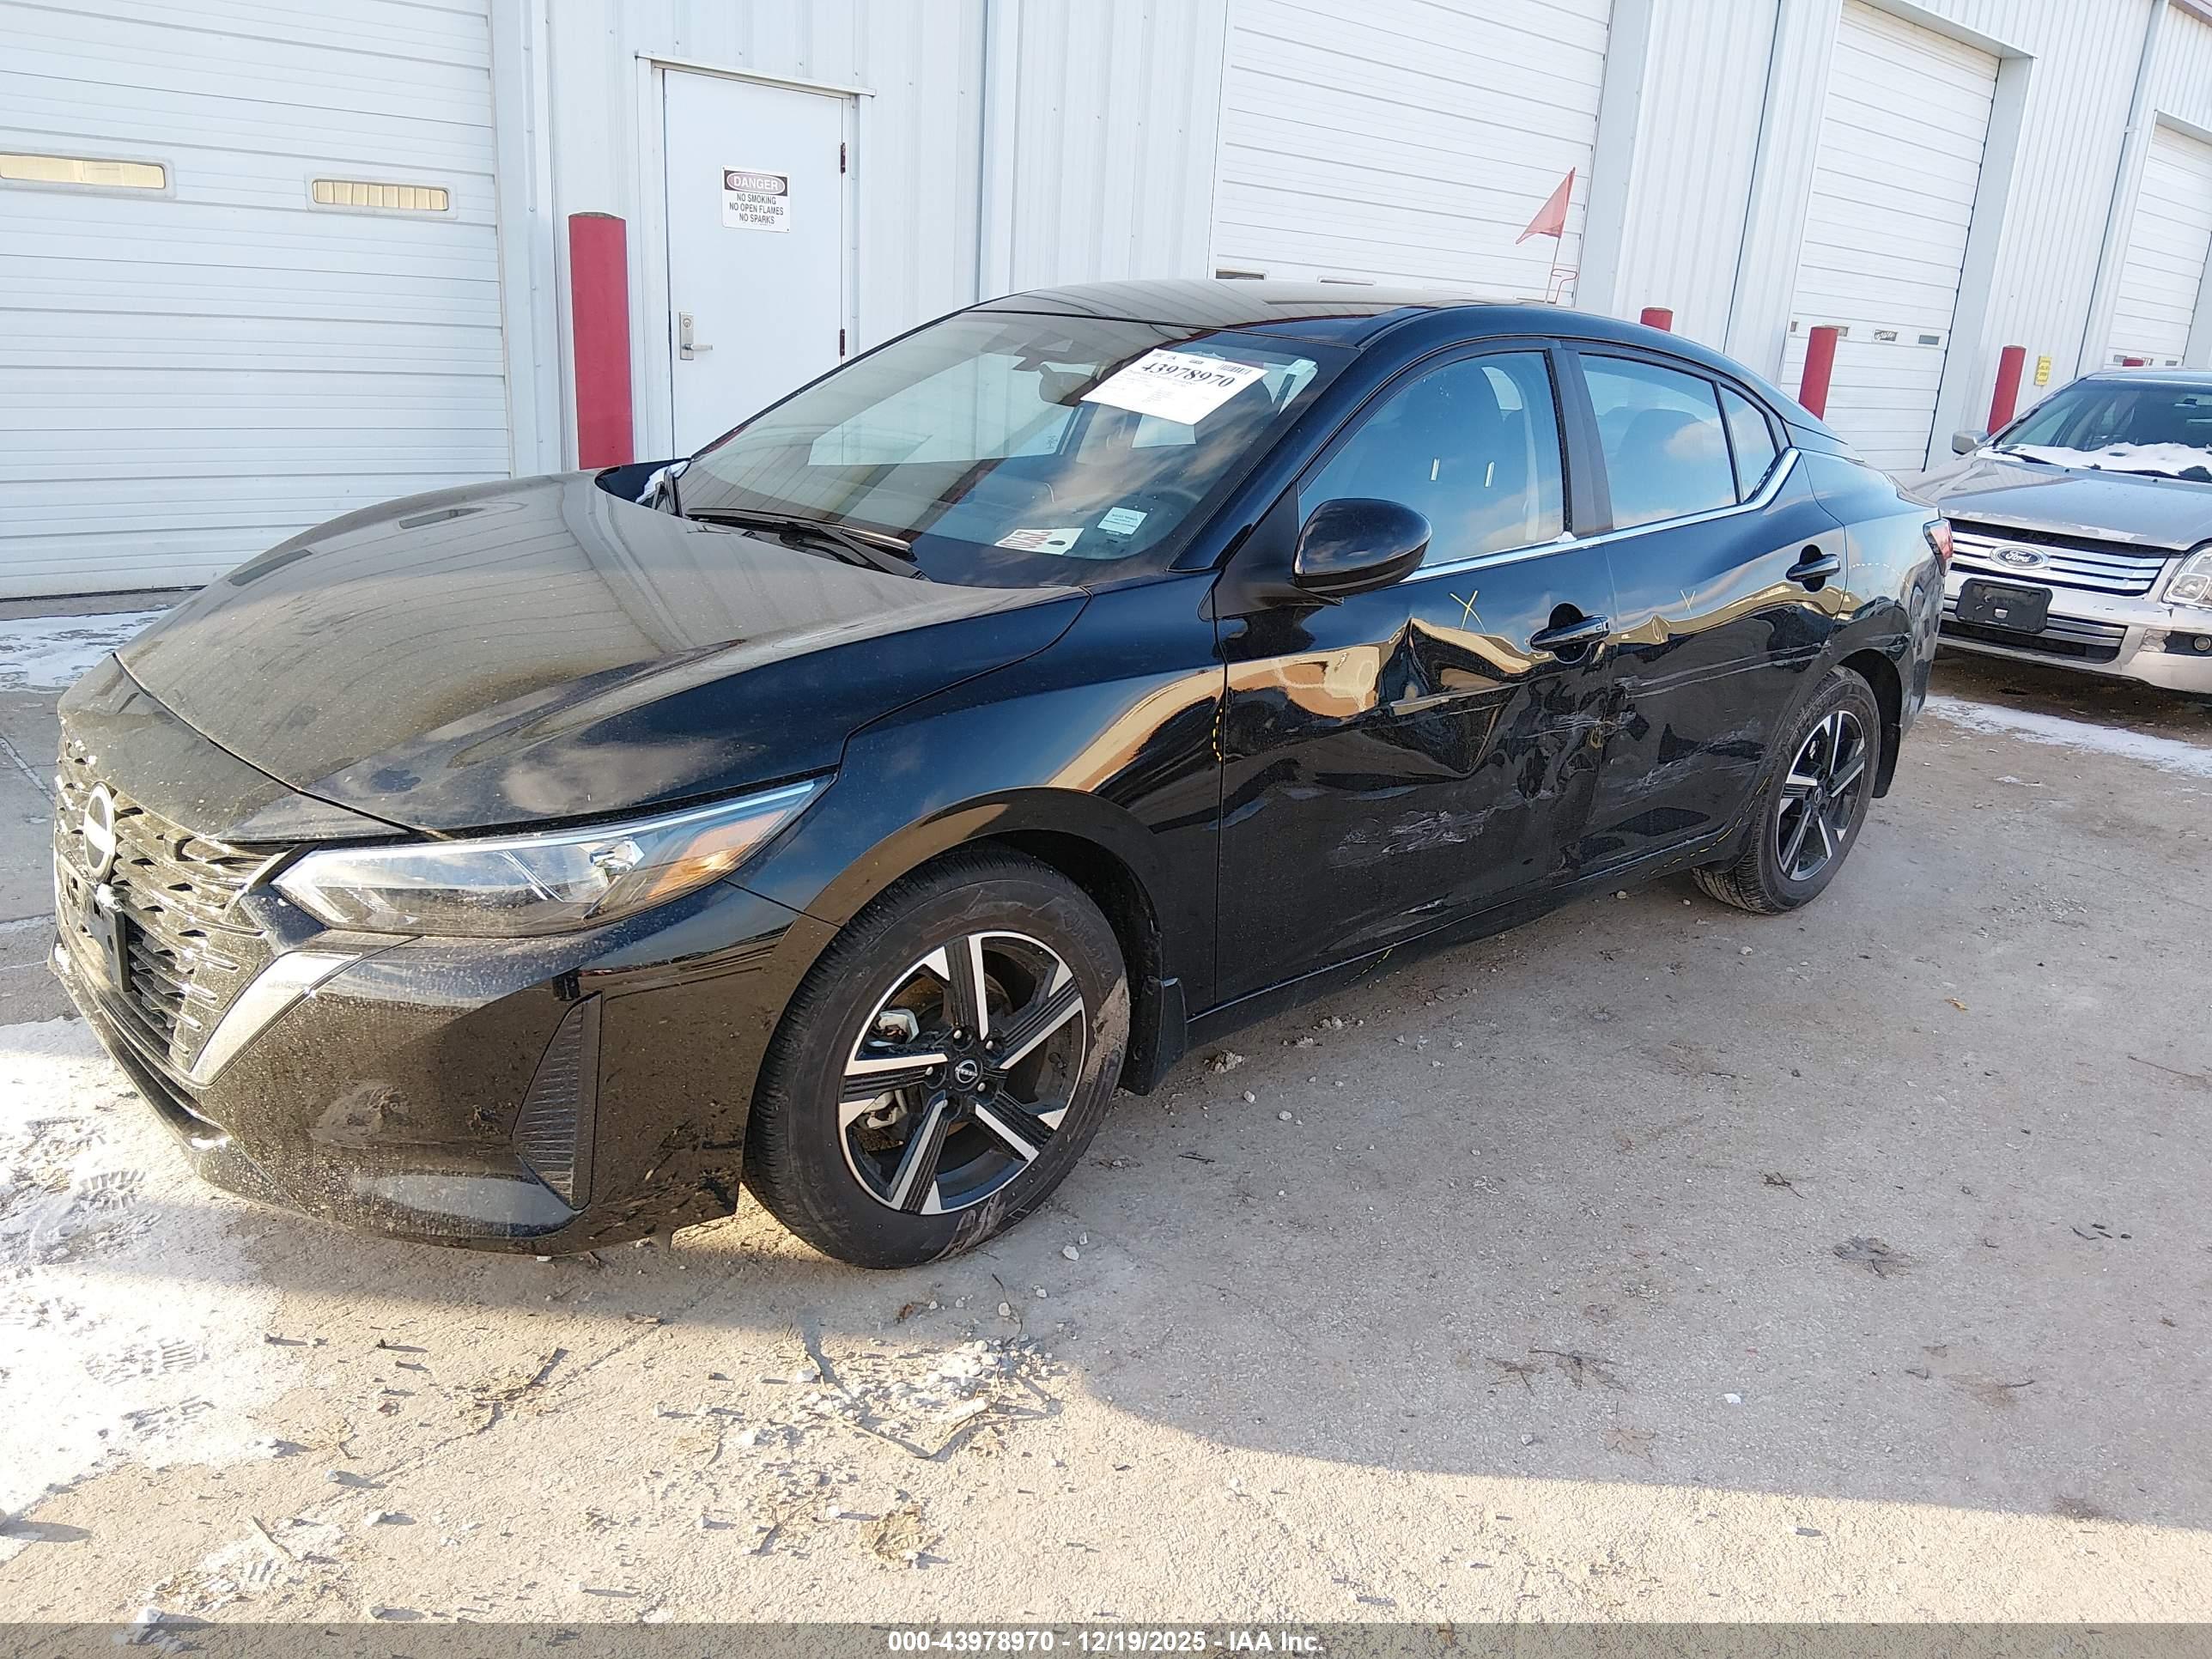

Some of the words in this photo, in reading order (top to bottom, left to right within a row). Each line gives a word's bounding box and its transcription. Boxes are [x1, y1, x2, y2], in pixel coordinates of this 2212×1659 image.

[734, 176, 778, 191] DANGER
[737, 193, 746, 202] NO
[747, 194, 776, 204] SMOKING
[729, 202, 739, 211] NO
[740, 203, 758, 213] OPEN
[759, 205, 784, 216] FLAMES
[739, 213, 749, 222] NO
[750, 214, 775, 224] SPARKS
[1142, 362, 1236, 388] 43978970
[2005, 550, 2032, 562] Ford
